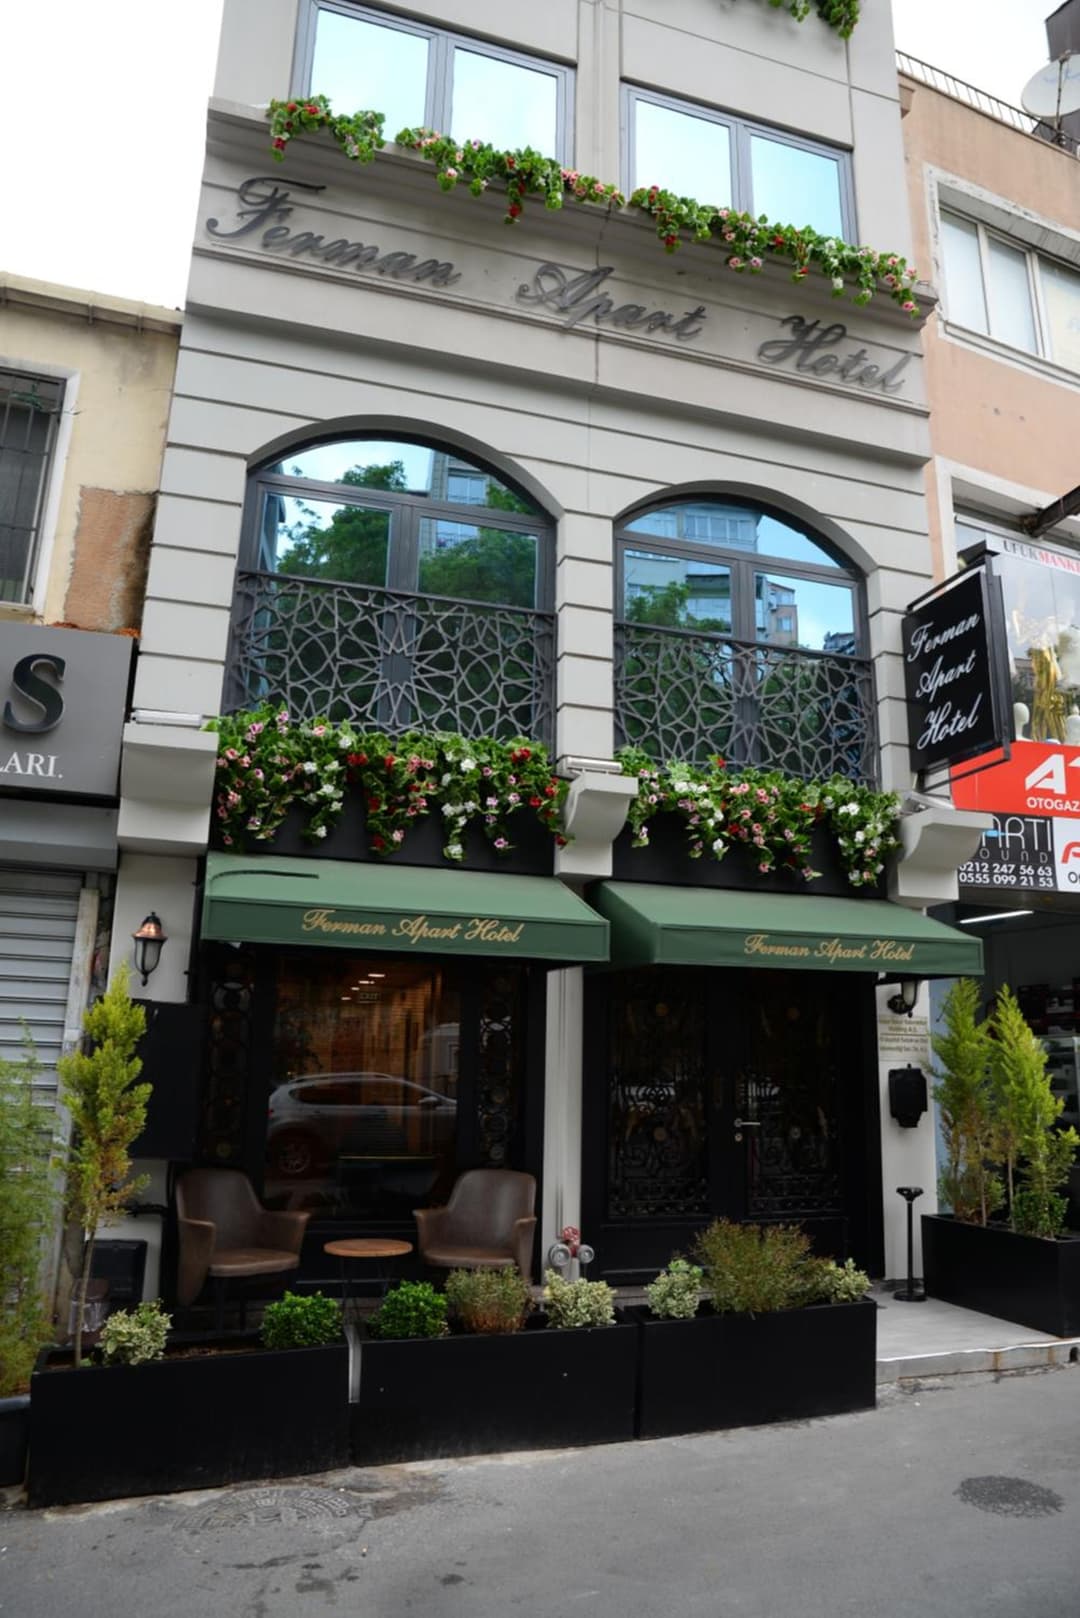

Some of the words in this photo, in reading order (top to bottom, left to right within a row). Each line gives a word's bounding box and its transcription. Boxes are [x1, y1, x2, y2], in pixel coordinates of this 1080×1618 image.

[206, 176, 462, 286] Ferman
[516, 262, 706, 341] Apart
[758, 314, 916, 393] Hotel
[907, 612, 980, 662] Ferman
[915, 650, 976, 702] Apart
[917, 693, 982, 750] Hotel
[0, 751, 64, 779] ARI.
[1026, 796, 1080, 813] OTOGAZ
[959, 872, 990, 884] 0555
[993, 874, 1017, 885] 099
[1020, 876, 1034, 887] 21
[1038, 877, 1054, 888] 53
[992, 863, 1016, 874] 247
[1019, 865, 1035, 876] 56
[1037, 866, 1053, 877] 63
[302, 909, 387, 934] Ferman
[391, 915, 463, 944] Apart
[464, 918, 525, 943] Hotel
[744, 934, 809, 956] Ferman
[814, 938, 867, 964] Apart
[869, 939, 916, 960] Hotel
